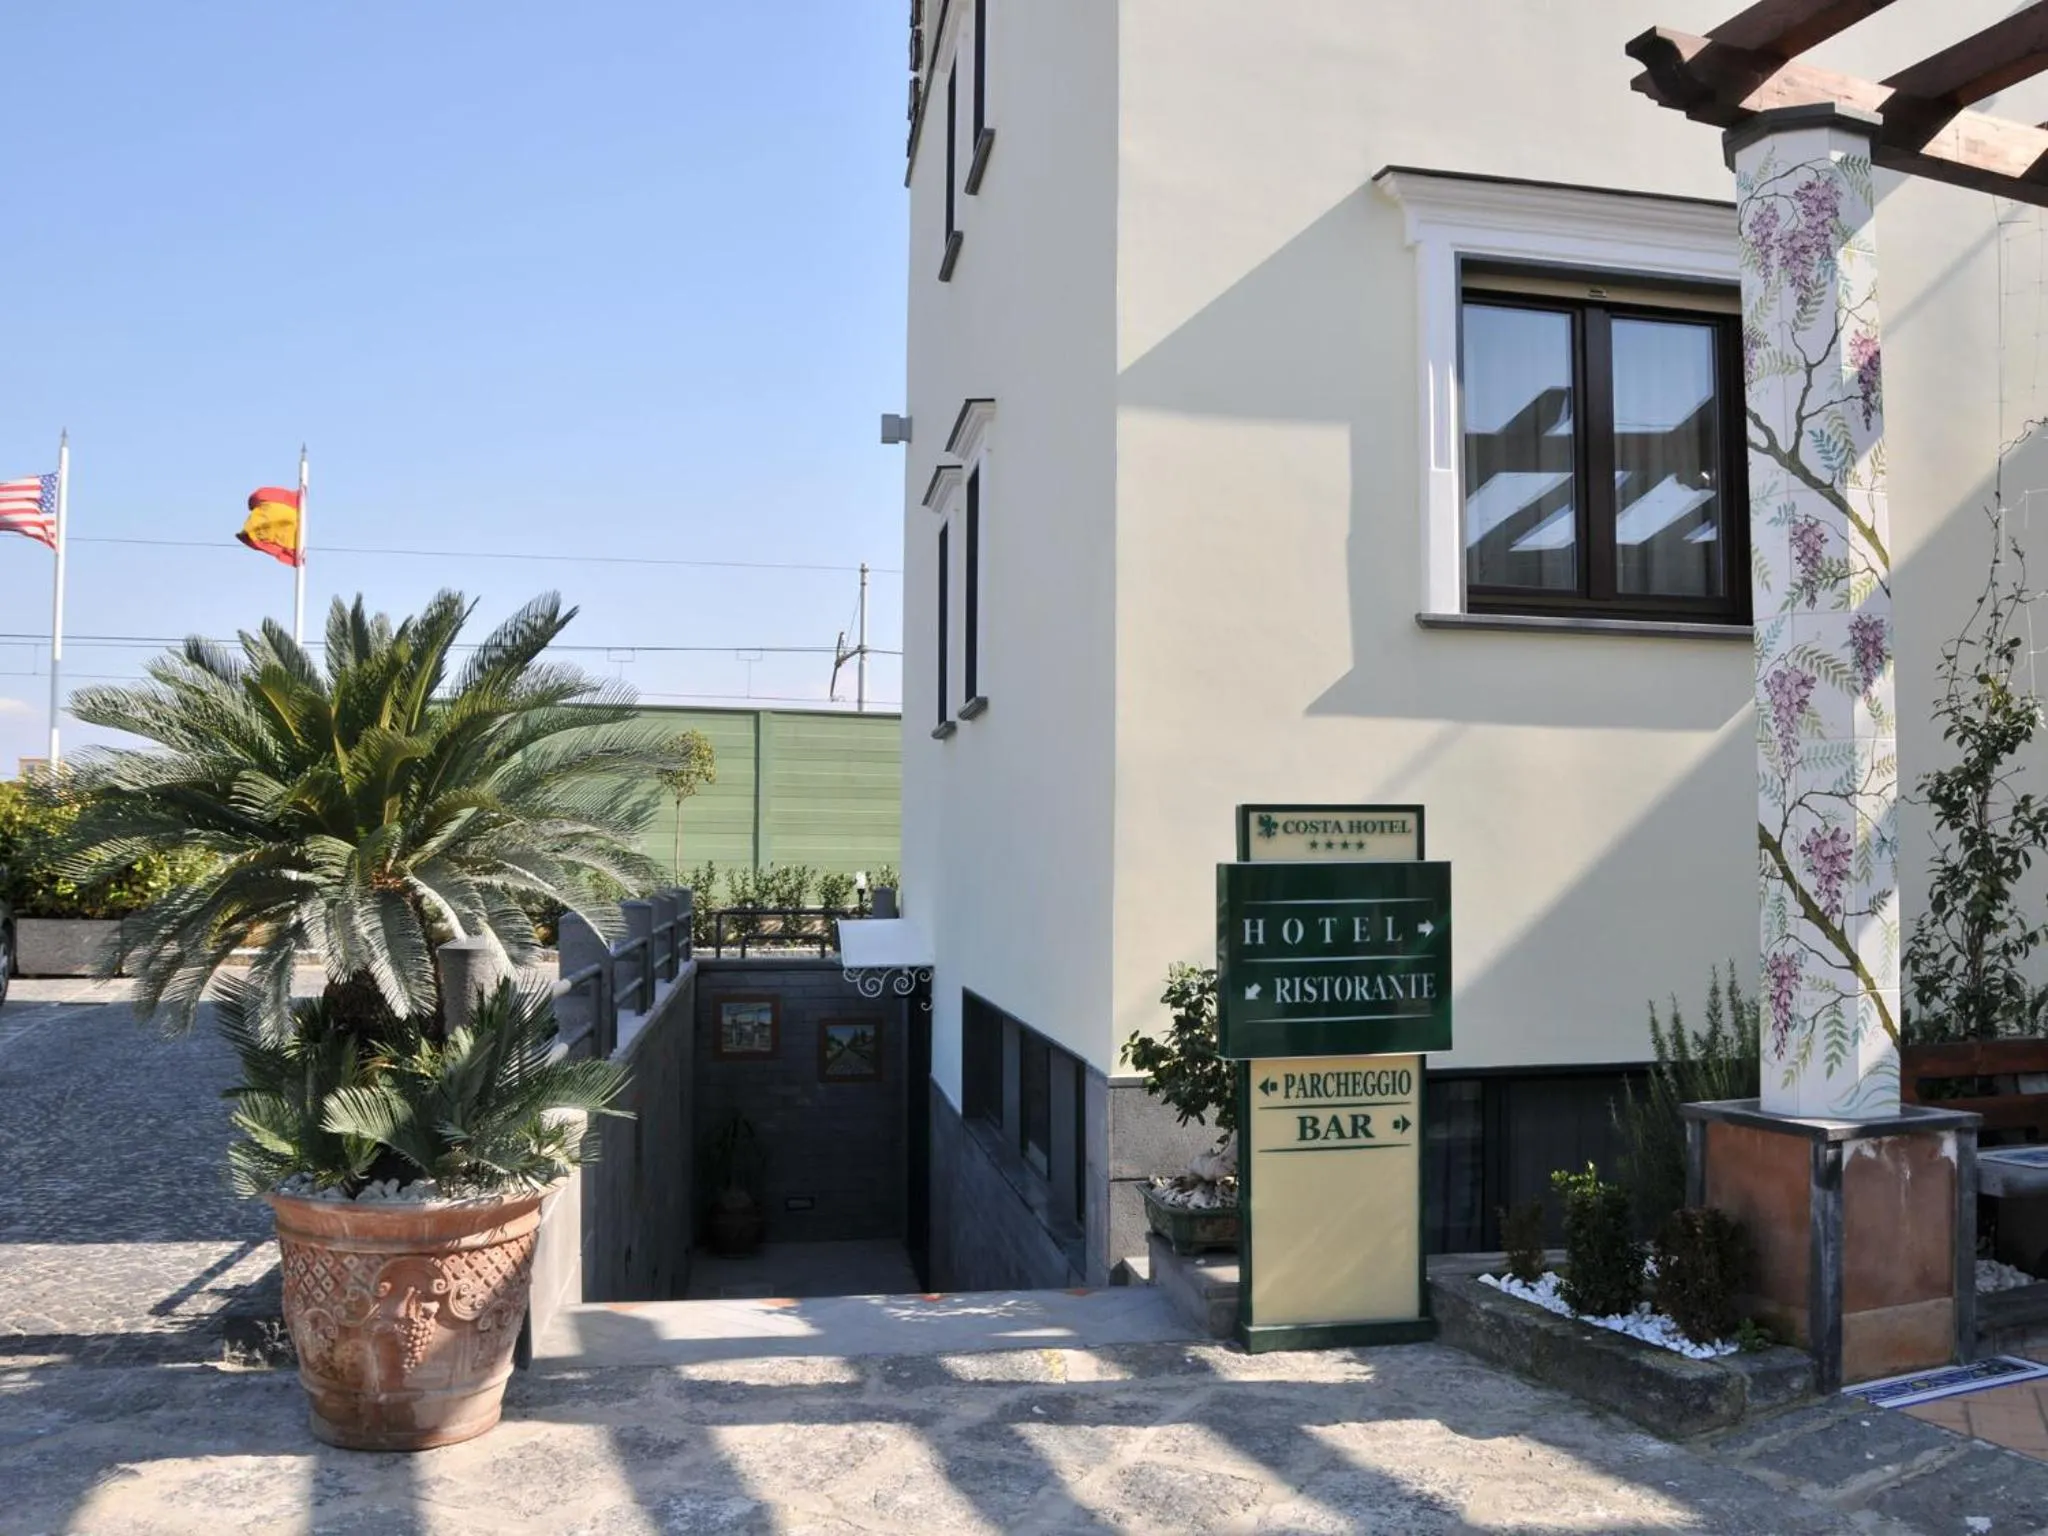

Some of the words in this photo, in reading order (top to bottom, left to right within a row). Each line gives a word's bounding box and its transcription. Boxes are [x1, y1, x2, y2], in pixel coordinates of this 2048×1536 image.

[1282, 819, 1344, 835] COSTA
[1348, 819, 1412, 834] HOTEL
[1242, 915, 1403, 946] HOTEL
[1274, 973, 1437, 1004] RISTORANTE
[1283, 1069, 1412, 1099] PARCHEGGIO
[1297, 1113, 1375, 1141] BAR
